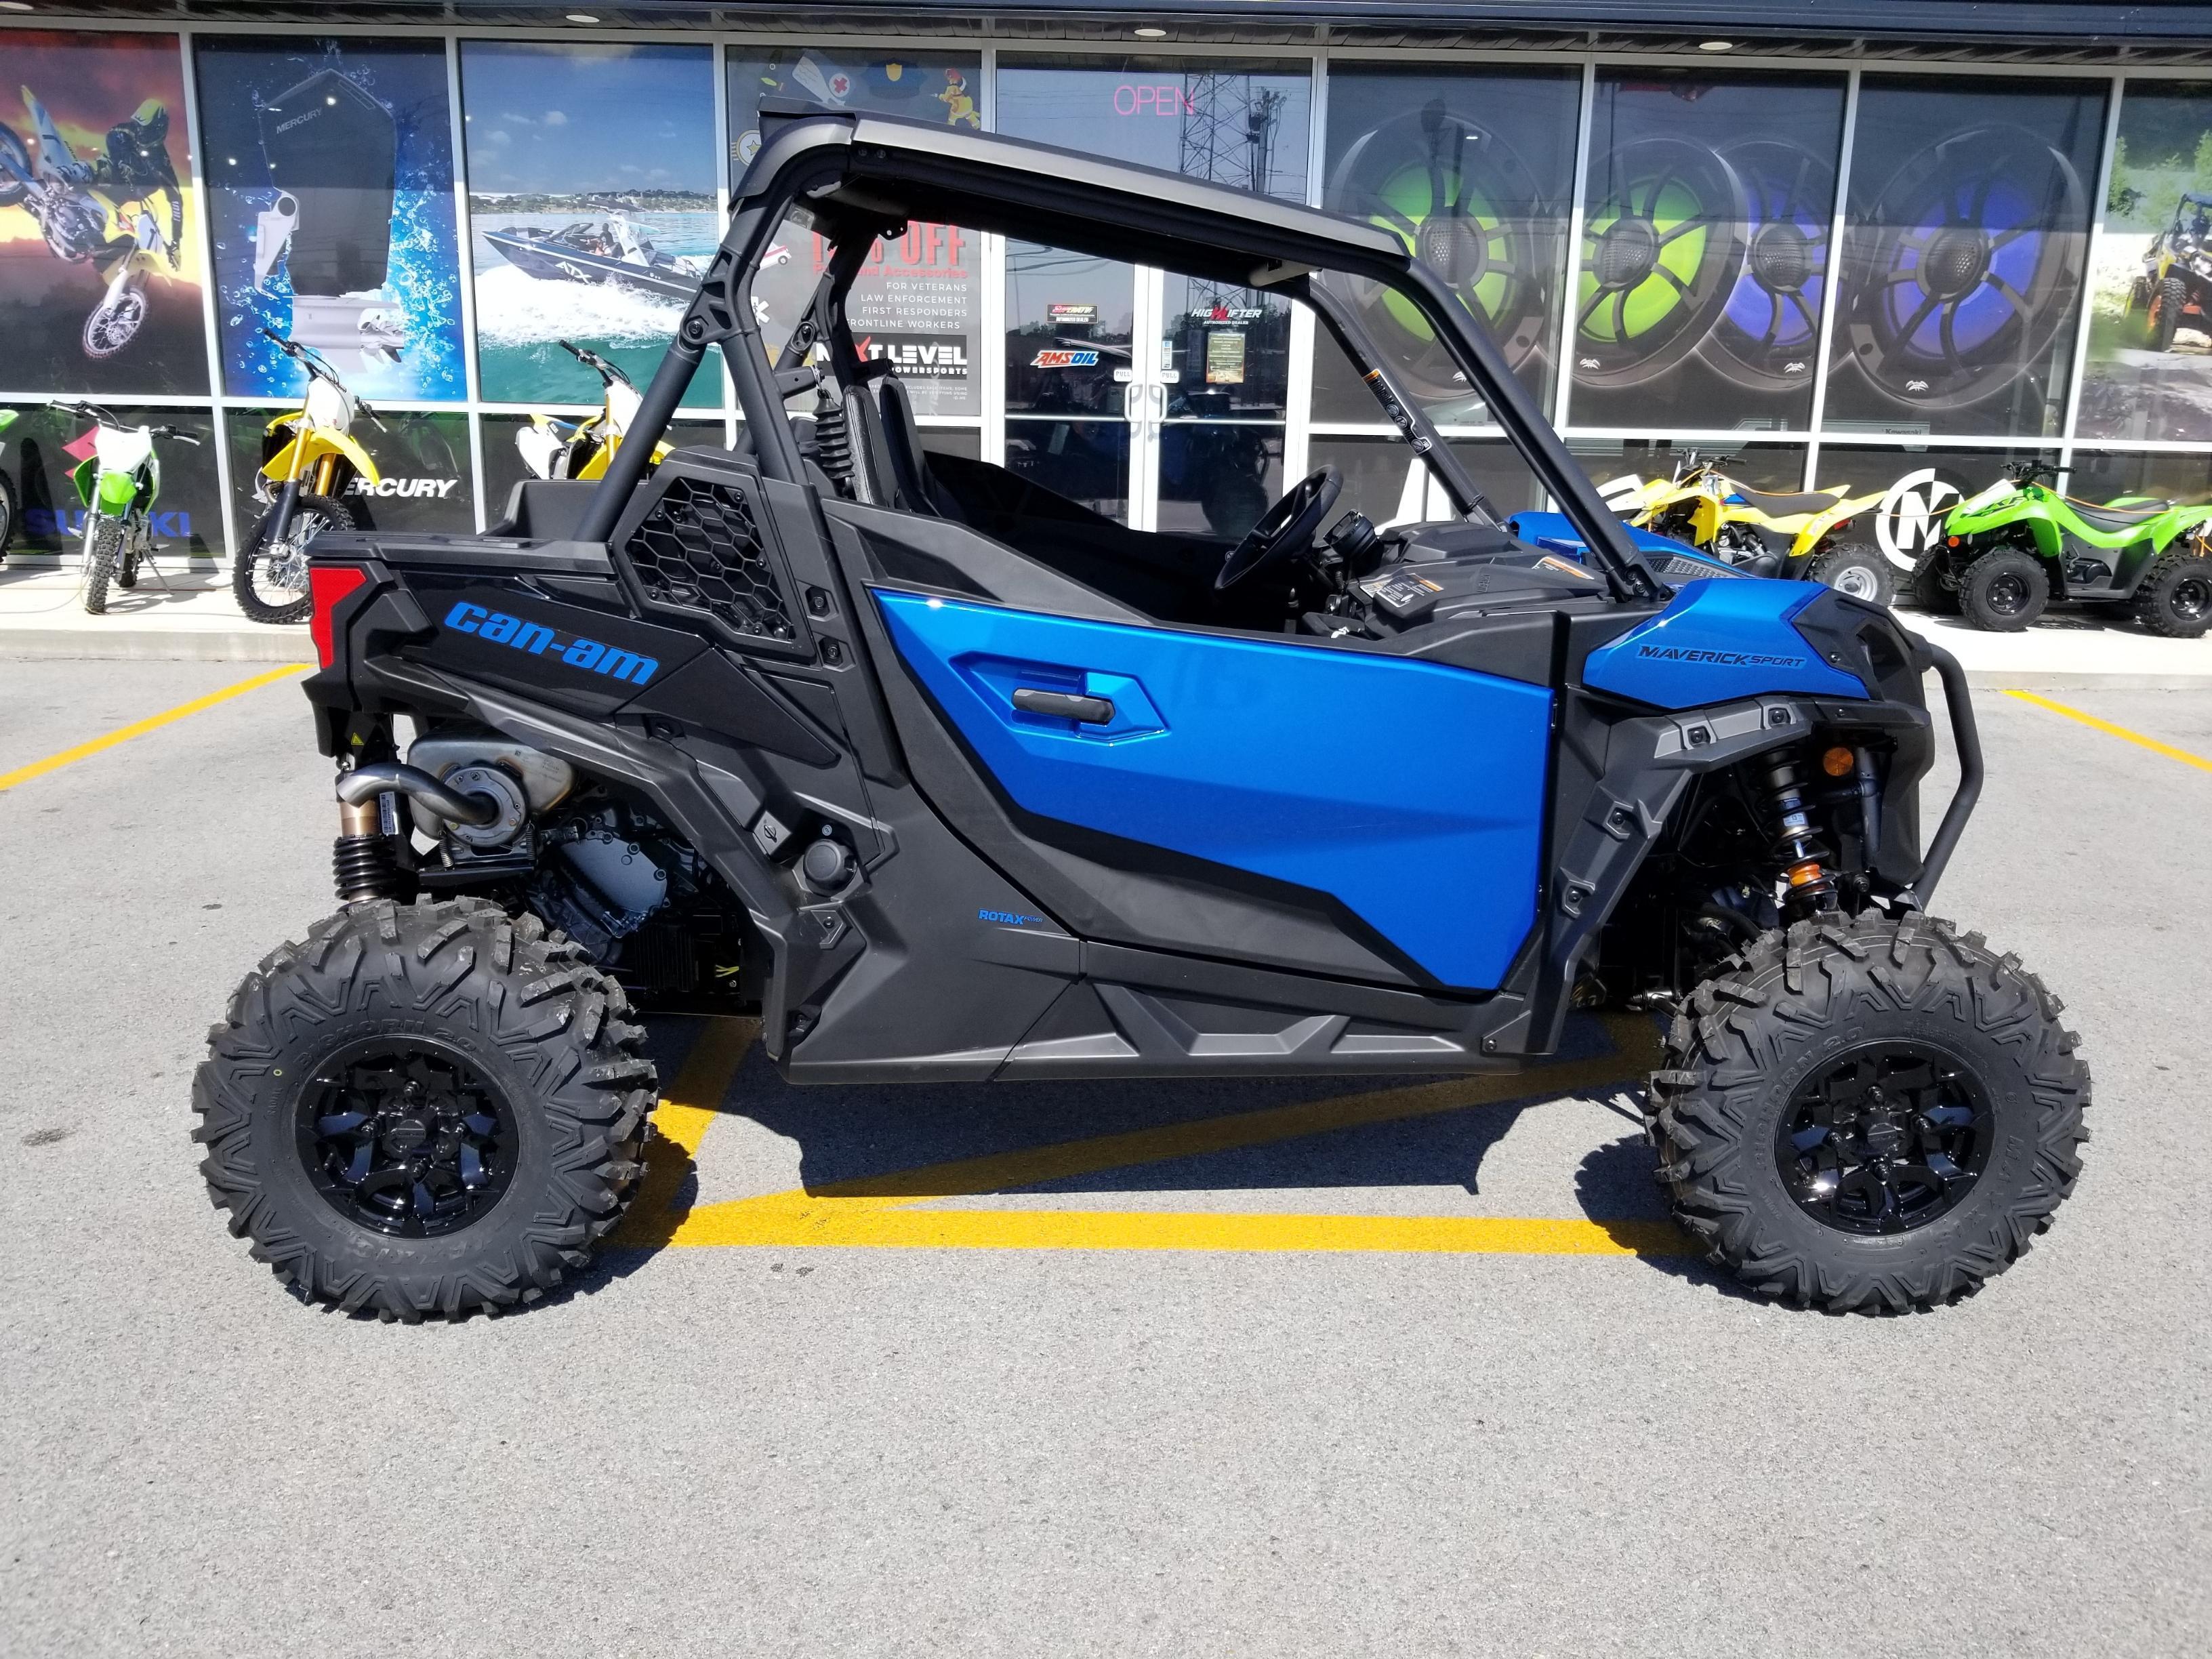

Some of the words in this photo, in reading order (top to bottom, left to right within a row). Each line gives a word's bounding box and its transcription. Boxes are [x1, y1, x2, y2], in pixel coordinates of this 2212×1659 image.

[1113, 85, 1194, 116] OPEN
[276, 107, 322, 134] MERCURY
[900, 220, 965, 266] OFF
[883, 264, 968, 279] Accessories
[886, 282, 907, 290] FOR
[912, 283, 967, 291] VETERANS
[861, 294, 884, 302] LAW
[888, 295, 967, 304] ENFORCEMENT
[862, 306, 892, 314] FIRST
[896, 308, 967, 316] RESPONDERS
[907, 321, 960, 329] WORKERS
[816, 336, 883, 363] NXT
[887, 345, 968, 365] LEVEL
[1035, 352, 1099, 367] AMSOIL
[891, 366, 968, 375] OWERSPORTS
[344, 478, 457, 497] ERCURY
[24, 509, 191, 537] SUKI
[444, 600, 659, 686] can-am
[1638, 645, 1750, 665] MAVERICK
[1749, 655, 1805, 667] SPORT
[979, 909, 1025, 925] ROTAX
